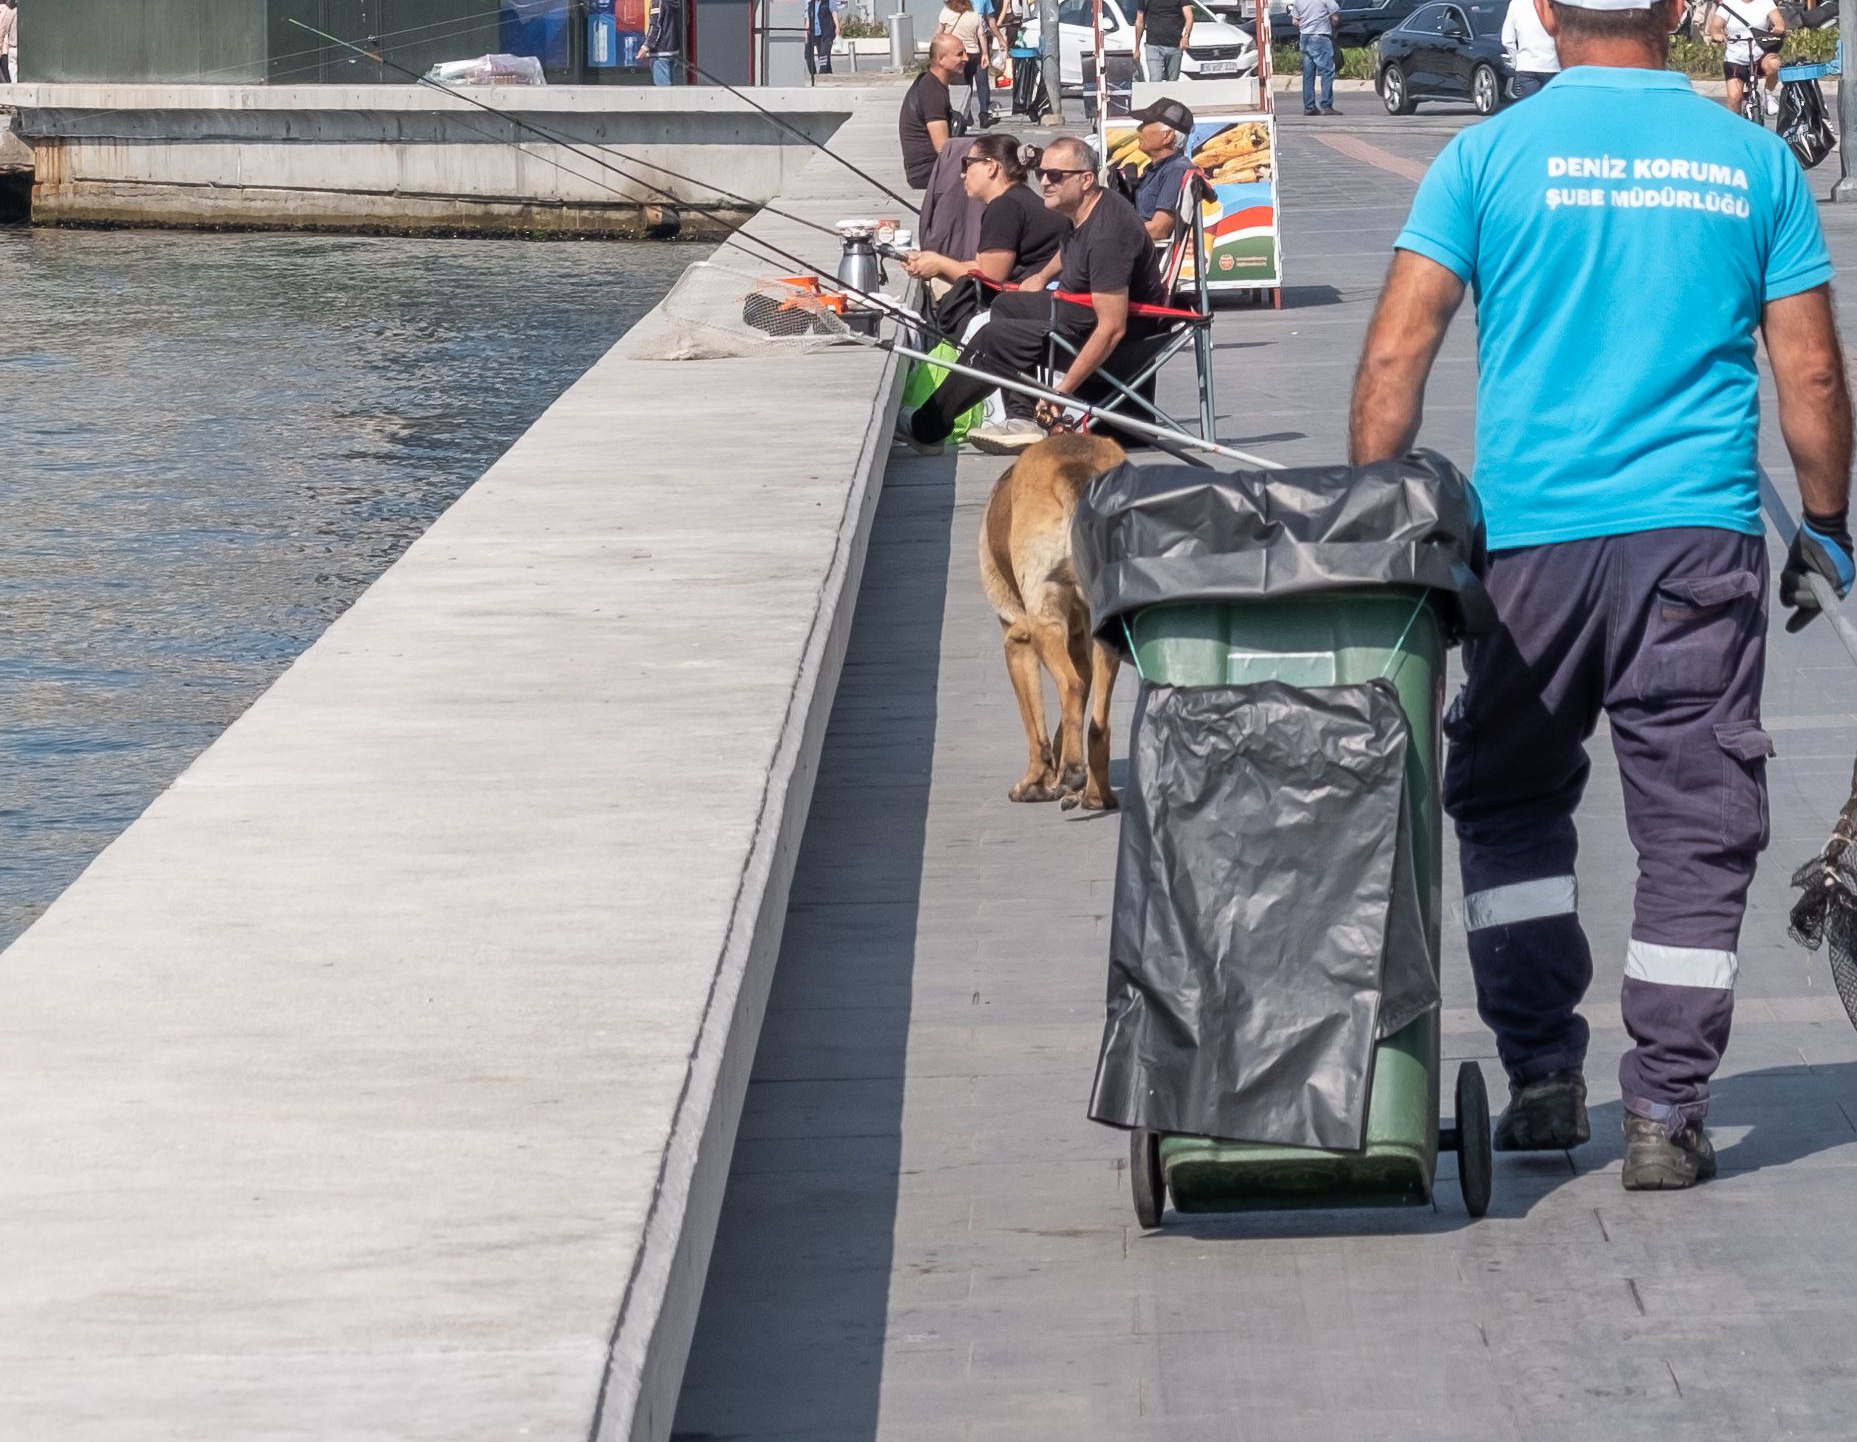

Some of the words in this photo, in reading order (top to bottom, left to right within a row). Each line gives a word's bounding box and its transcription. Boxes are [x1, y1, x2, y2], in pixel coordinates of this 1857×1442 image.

[1547, 153, 1627, 179] DENİZ
[1633, 158, 1749, 190] KORUMA
[1545, 188, 1605, 210] ŞUBE
[1611, 185, 1751, 219] MÜDÜRLÜĞÜ
